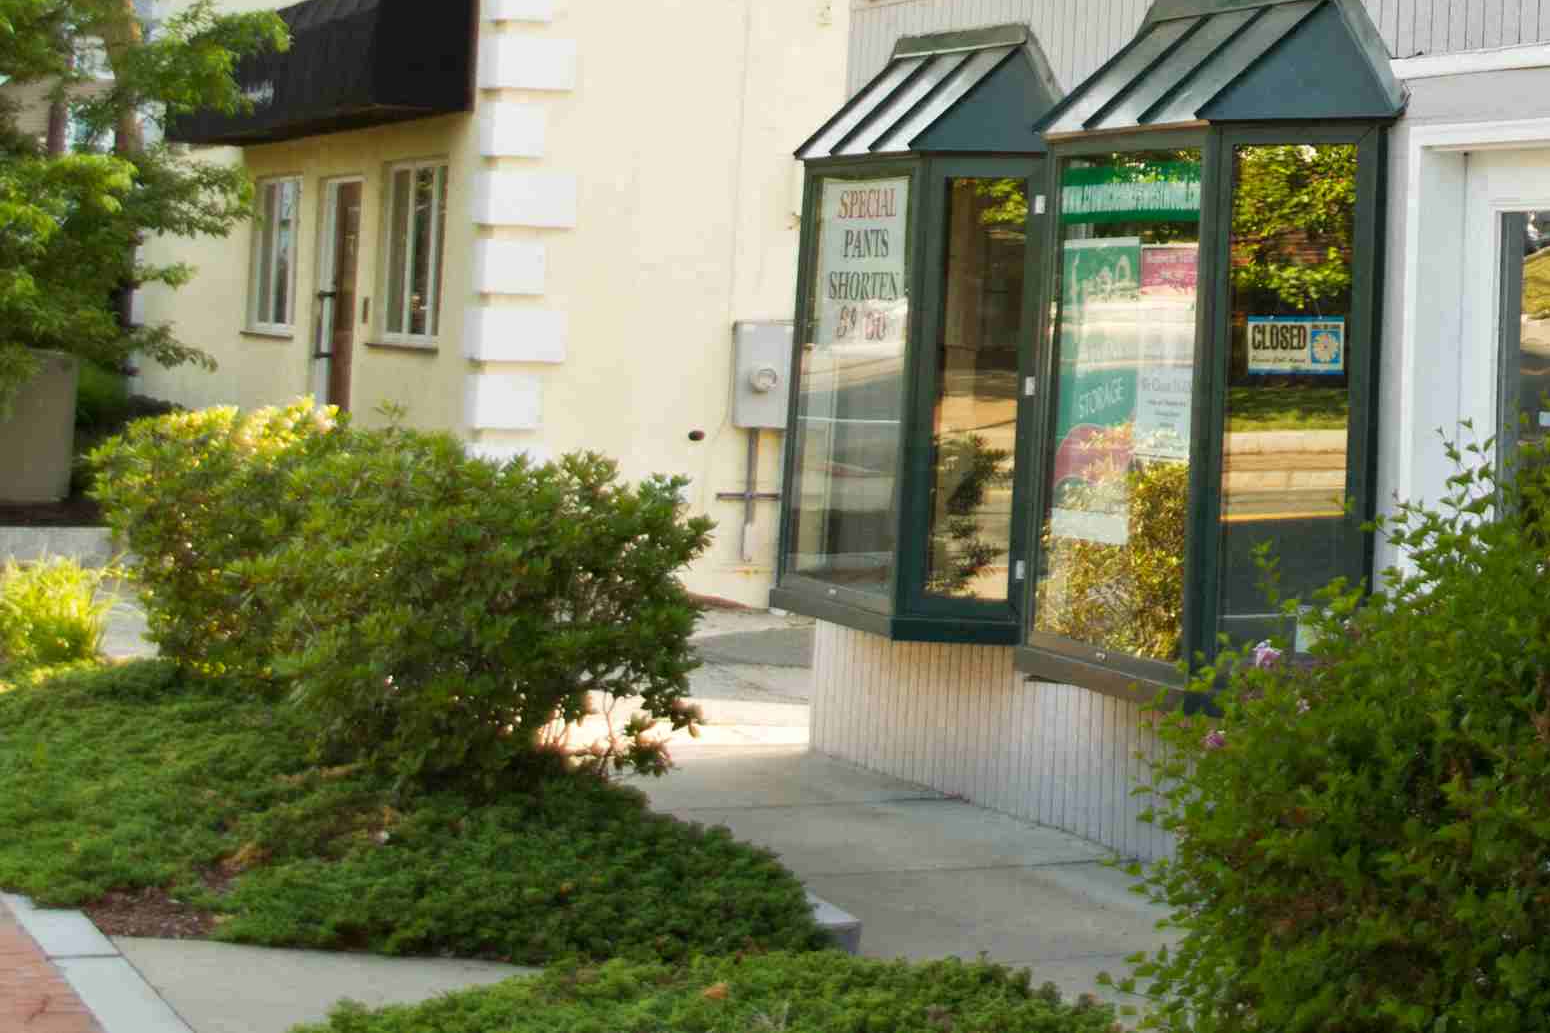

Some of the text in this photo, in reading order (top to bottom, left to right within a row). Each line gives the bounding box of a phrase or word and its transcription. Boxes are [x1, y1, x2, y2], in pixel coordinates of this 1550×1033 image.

[838, 188, 897, 219] SPECIAL
[843, 229, 889, 259] PANTS
[828, 271, 901, 301] SHORTEN
[1252, 324, 1307, 350] CLOSED
[1078, 376, 1125, 419] STORAGE
